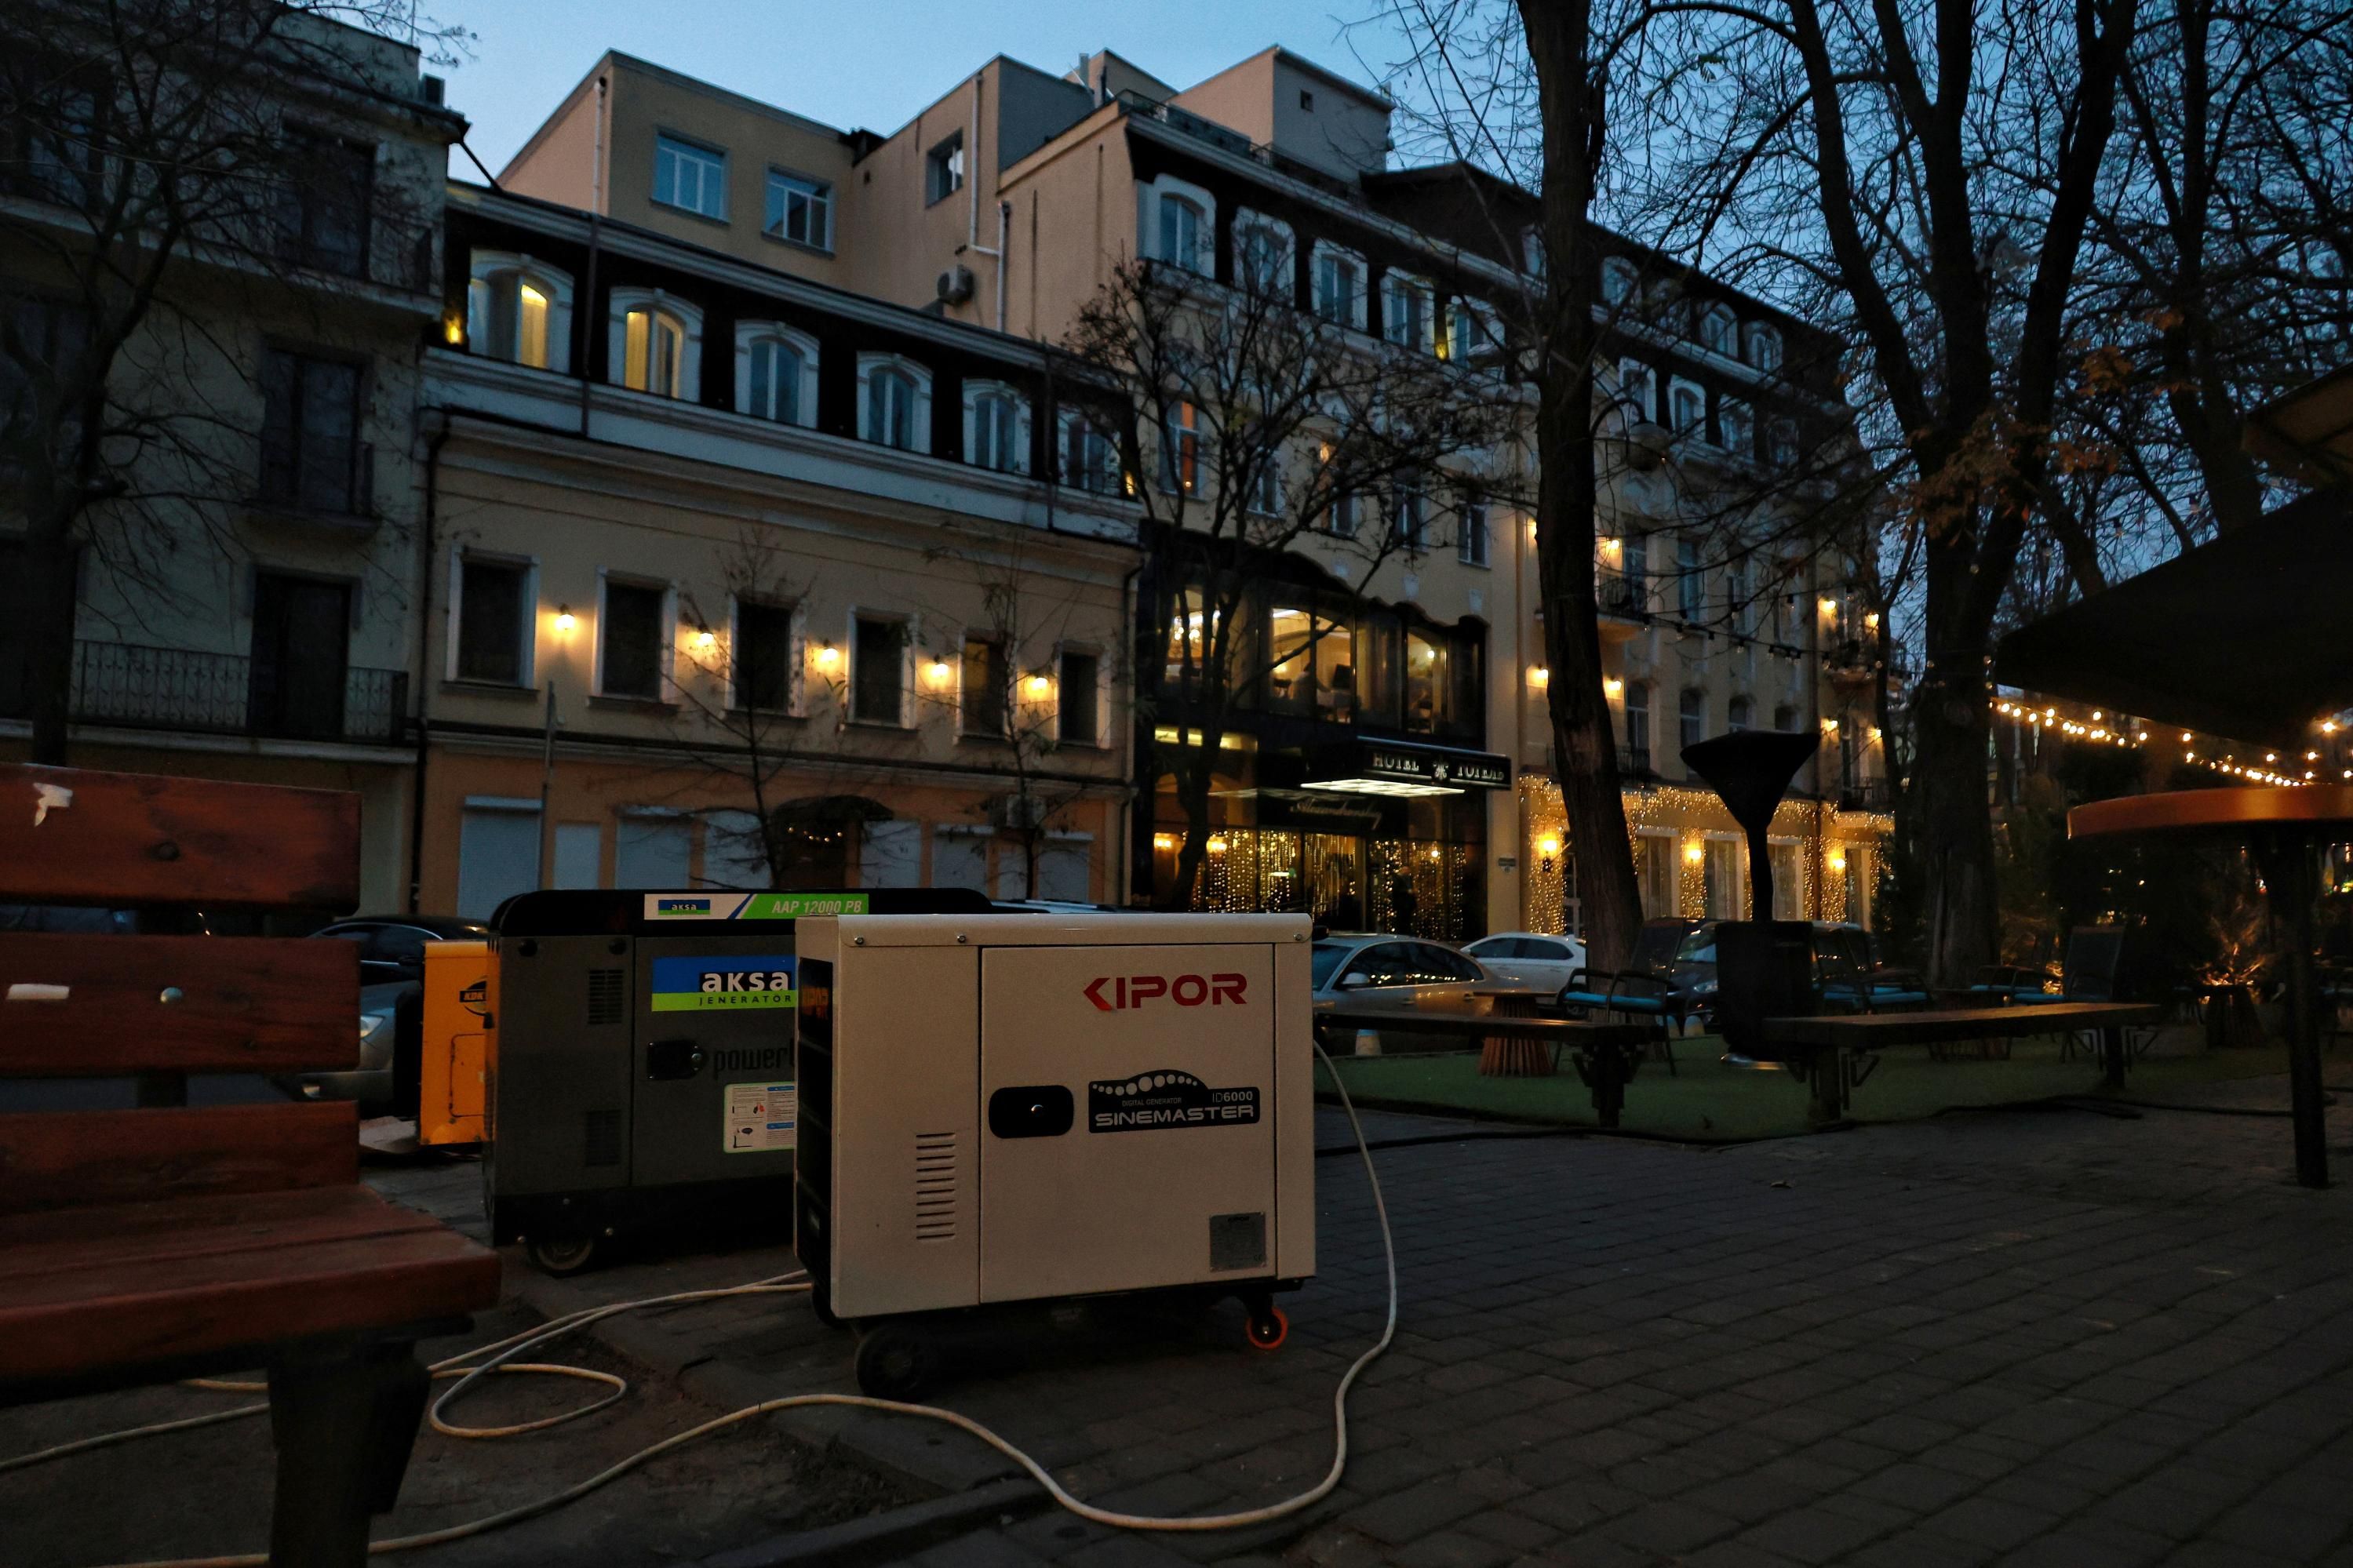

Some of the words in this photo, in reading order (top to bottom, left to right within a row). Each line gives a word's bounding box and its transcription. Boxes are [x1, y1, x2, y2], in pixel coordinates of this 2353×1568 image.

[1372, 751, 1419, 773] HOTEL
[771, 900, 800, 914] AAP
[803, 900, 841, 915] 12000
[845, 900, 862, 913] PB
[701, 971, 789, 993] aksa
[1083, 973, 1248, 1011] KIPOR
[1121, 1098, 1145, 1108] DIGITAL
[1146, 1097, 1182, 1106] GENERATOR
[1212, 1091, 1254, 1104] ID6000
[1095, 1104, 1255, 1127] SINEMASTER
